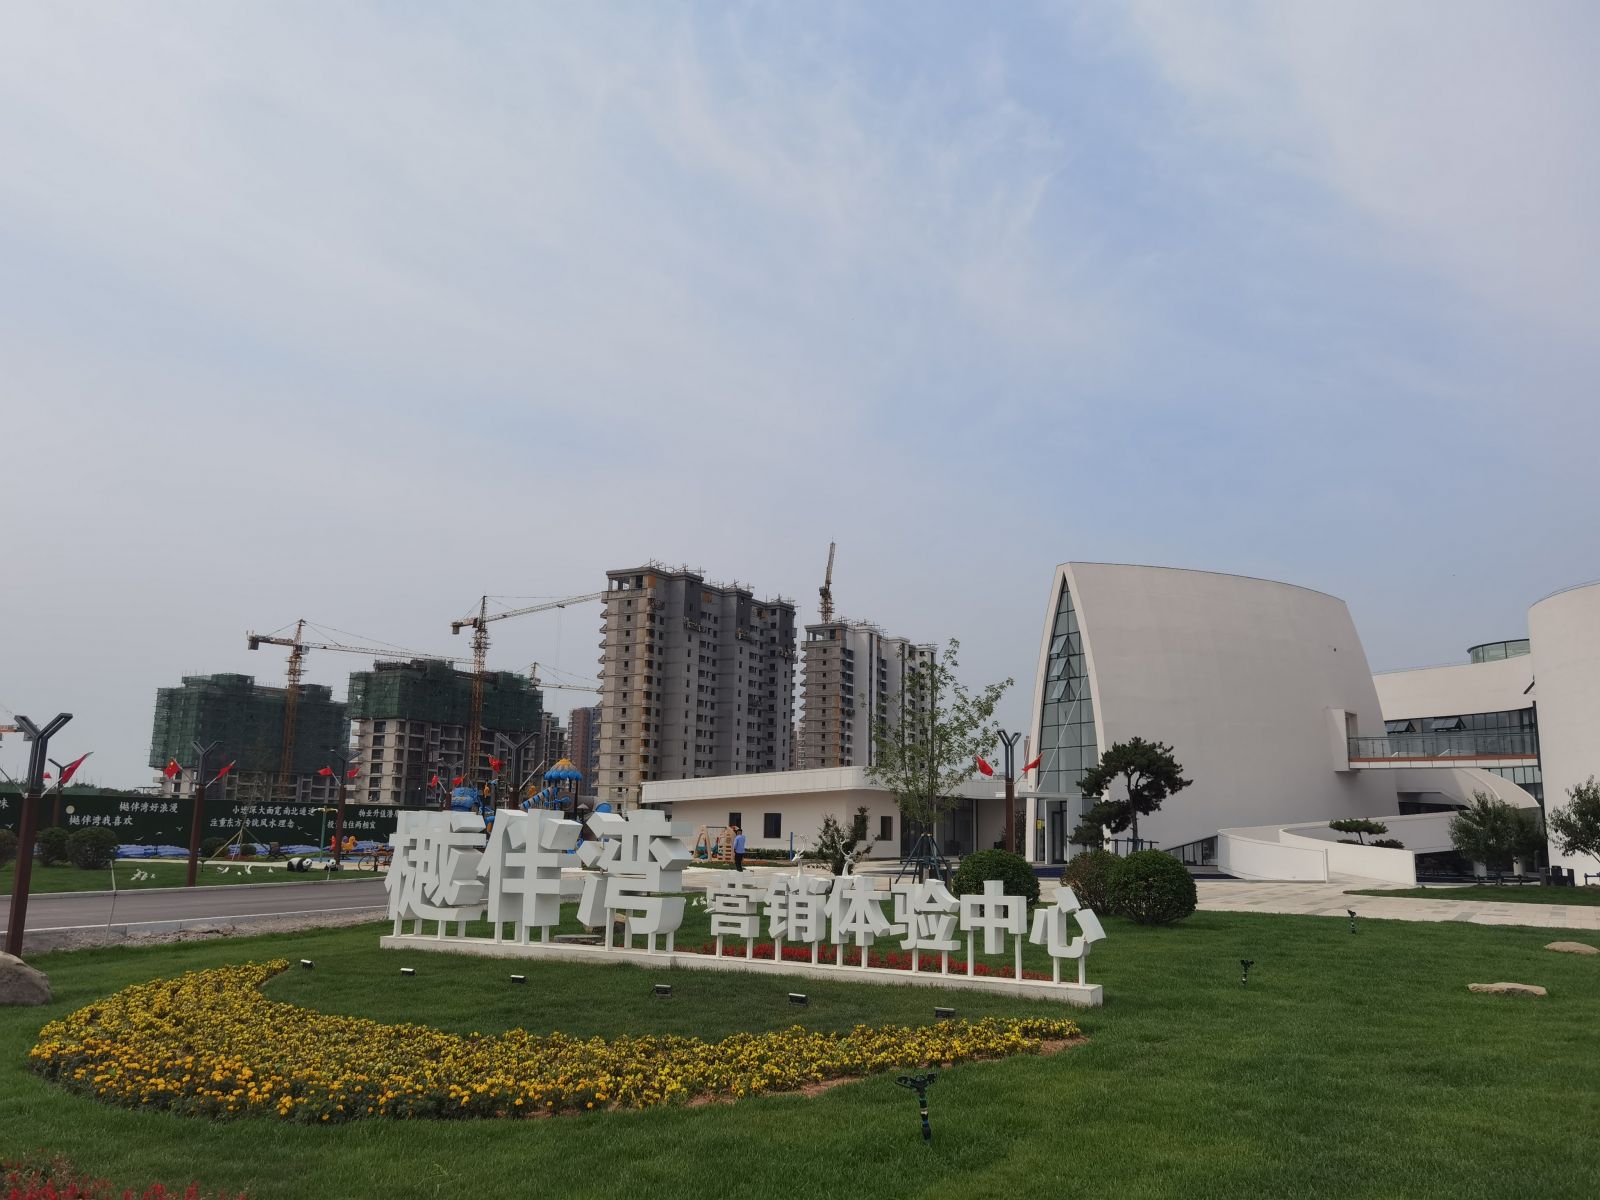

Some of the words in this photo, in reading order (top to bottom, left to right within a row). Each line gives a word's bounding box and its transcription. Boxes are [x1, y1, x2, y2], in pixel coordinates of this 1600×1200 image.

[327, 819, 376, 830] 投自住两相宜
[384, 809, 693, 935] 樾伴湾
[704, 870, 1107, 960] 营销体验中心
